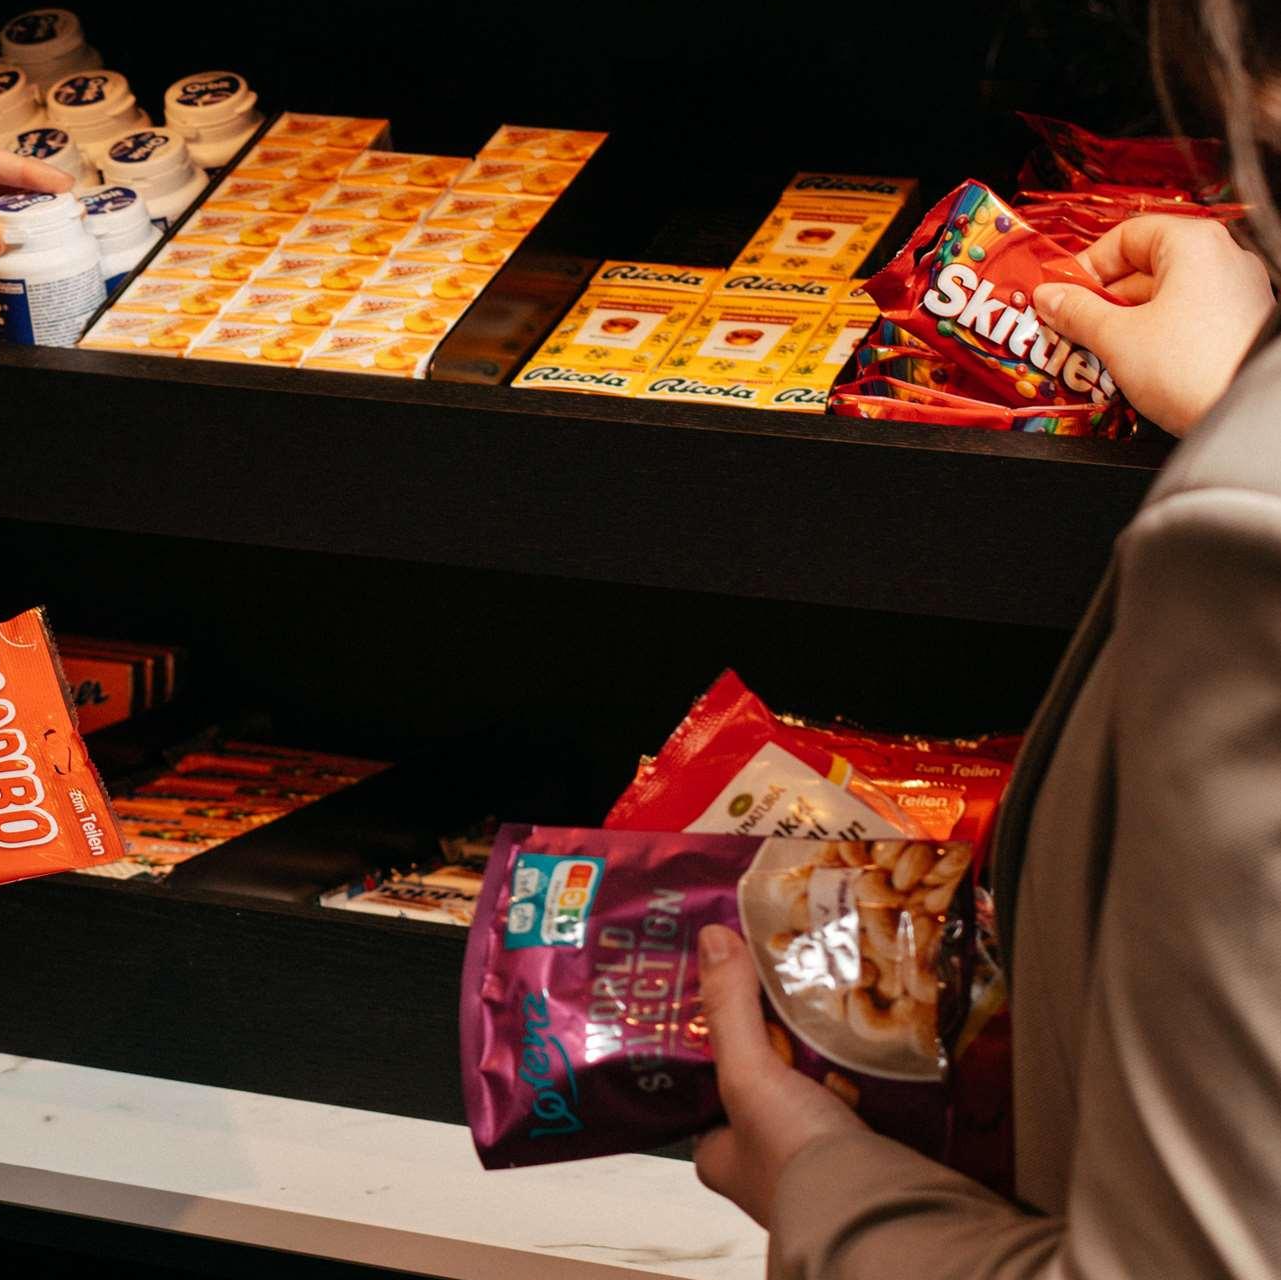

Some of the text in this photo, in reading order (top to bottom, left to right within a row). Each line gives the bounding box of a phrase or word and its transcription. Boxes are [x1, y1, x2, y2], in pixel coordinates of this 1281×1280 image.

[796, 176, 900, 194] Ricola
[602, 265, 704, 286] Ricola
[724, 275, 829, 296] Ricola
[524, 366, 627, 387] Ricola
[648, 377, 756, 400] Ricola
[951, 762, 1001, 778] Teilen
[897, 793, 949, 809] Teilen
[82, 815, 106, 856] Teilen
[584, 926, 636, 1063] WORLD
[627, 887, 687, 1092] SELECTION
[519, 993, 584, 1138] Lorenz
